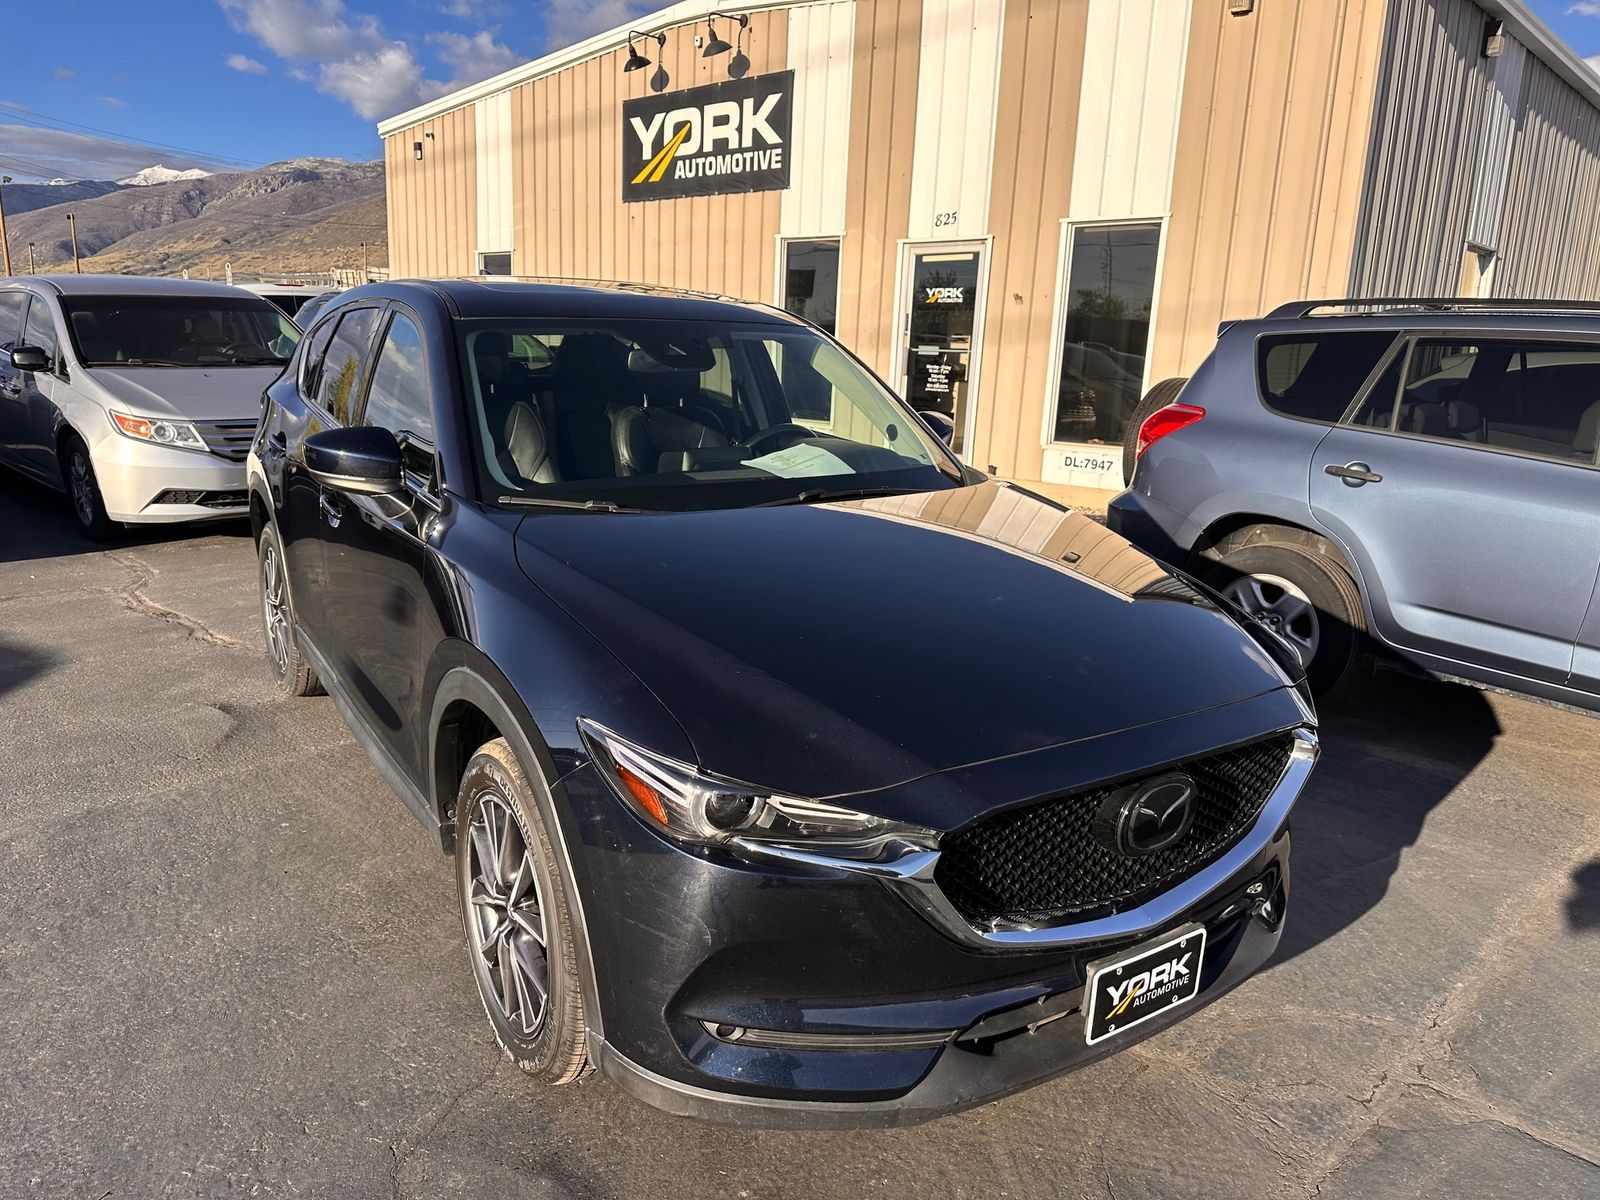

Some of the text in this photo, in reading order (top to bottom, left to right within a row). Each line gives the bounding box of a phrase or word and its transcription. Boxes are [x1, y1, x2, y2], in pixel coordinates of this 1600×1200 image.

[629, 92, 783, 161] YORK
[674, 148, 782, 180] AUTOMOTIVE
[935, 210, 957, 227] 825
[926, 287, 964, 298] YORK
[1064, 456, 1114, 471] DL:7947
[1106, 951, 1193, 1006] YORK
[1132, 974, 1190, 1008] AUTOMOTIVE
